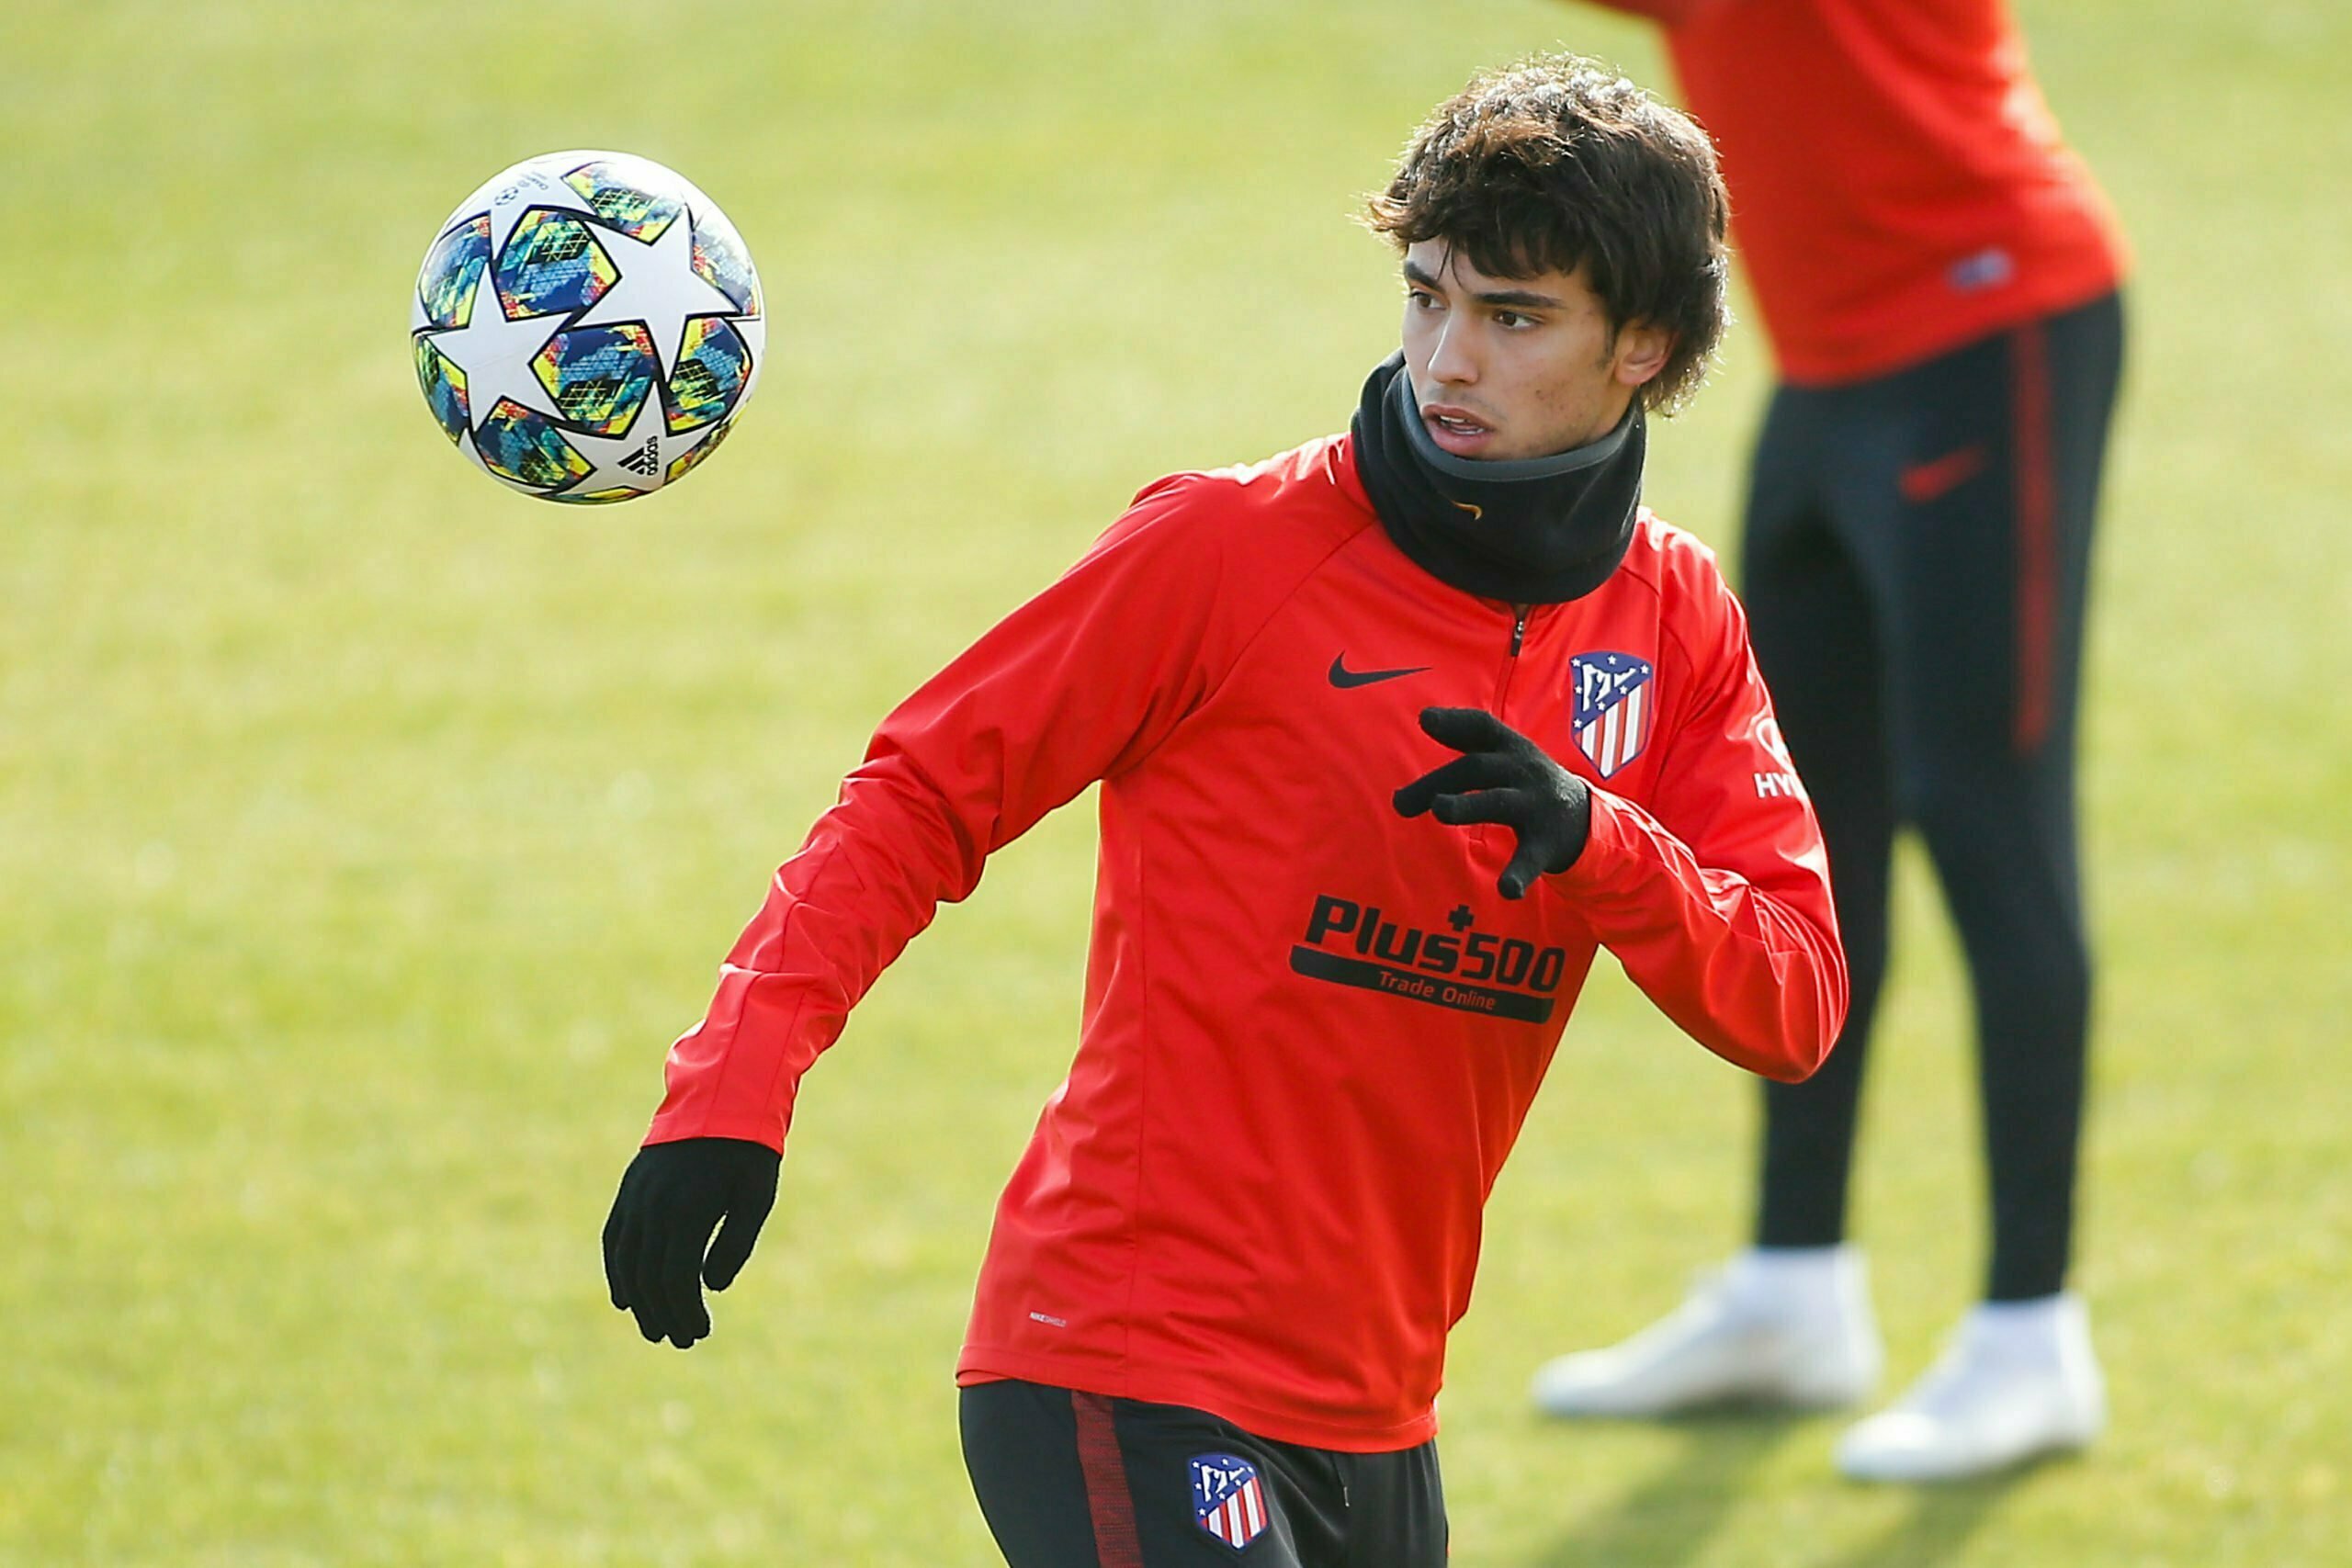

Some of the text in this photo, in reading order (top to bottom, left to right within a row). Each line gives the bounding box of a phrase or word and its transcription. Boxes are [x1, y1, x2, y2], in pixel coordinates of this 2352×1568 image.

[644, 435, 658, 476] adidas
[1305, 894, 1566, 993] Plus500
[1379, 971, 1497, 1010] Trade Online
